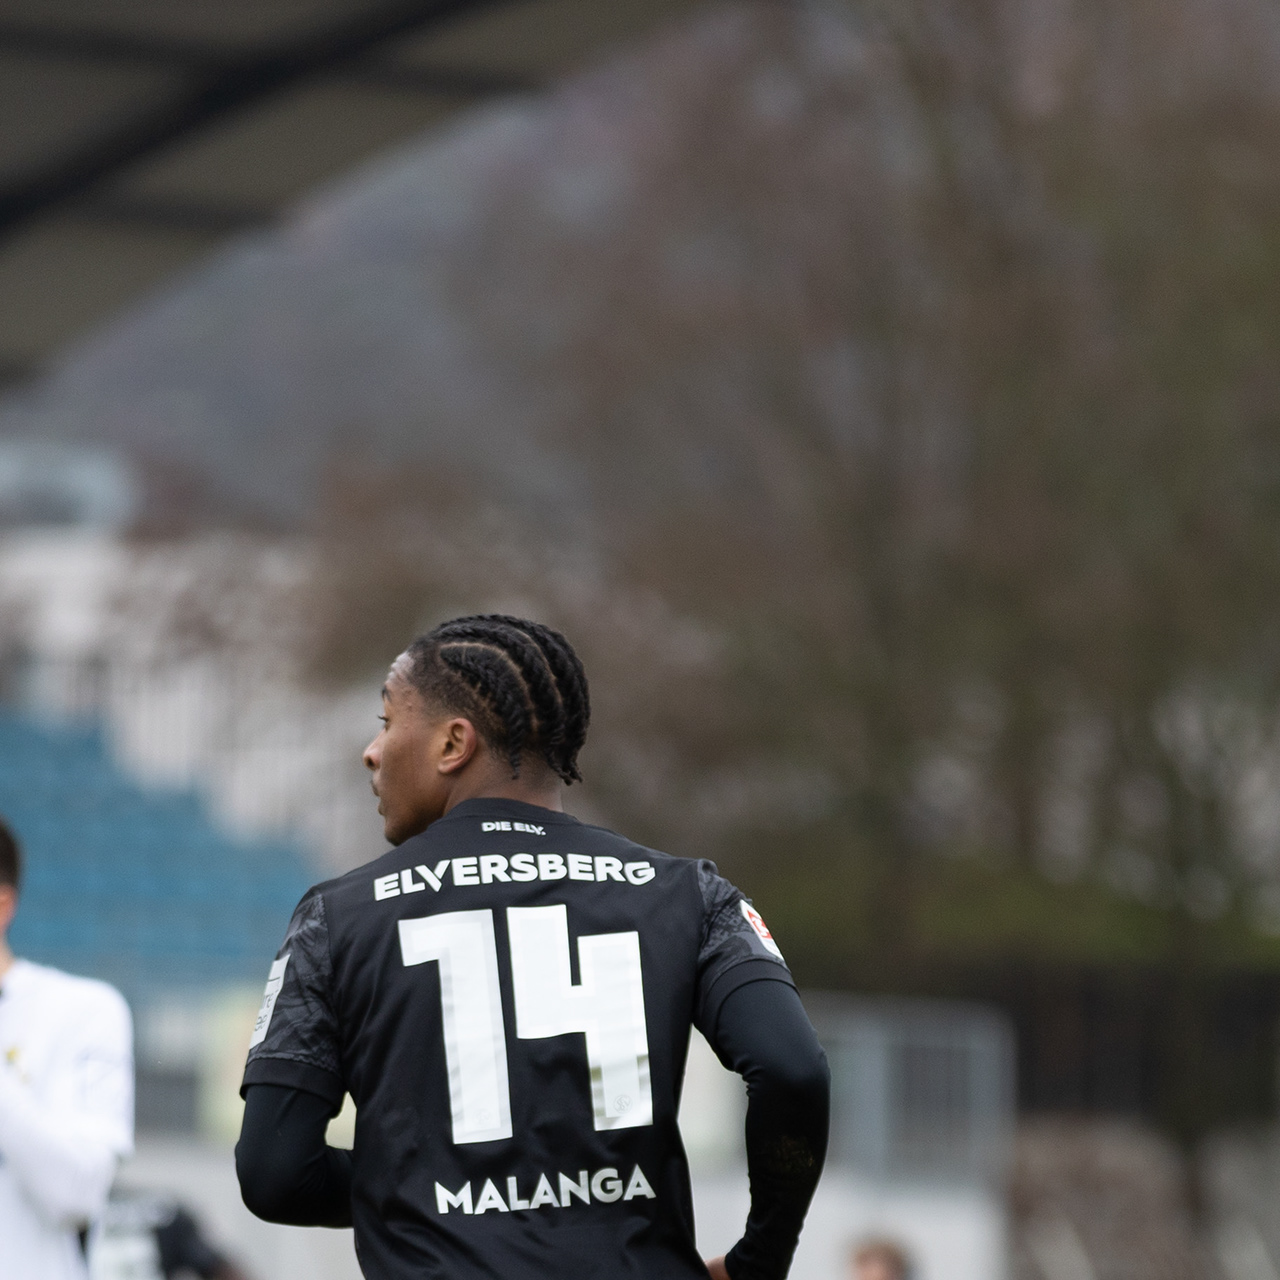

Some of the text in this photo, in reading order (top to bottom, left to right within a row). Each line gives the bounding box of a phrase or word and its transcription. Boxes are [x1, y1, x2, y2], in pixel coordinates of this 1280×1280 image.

[481, 821, 512, 832] DIE
[374, 853, 656, 902] ELVERSBERG
[397, 903, 653, 1145] 14
[434, 1164, 656, 1215] MALANGA
